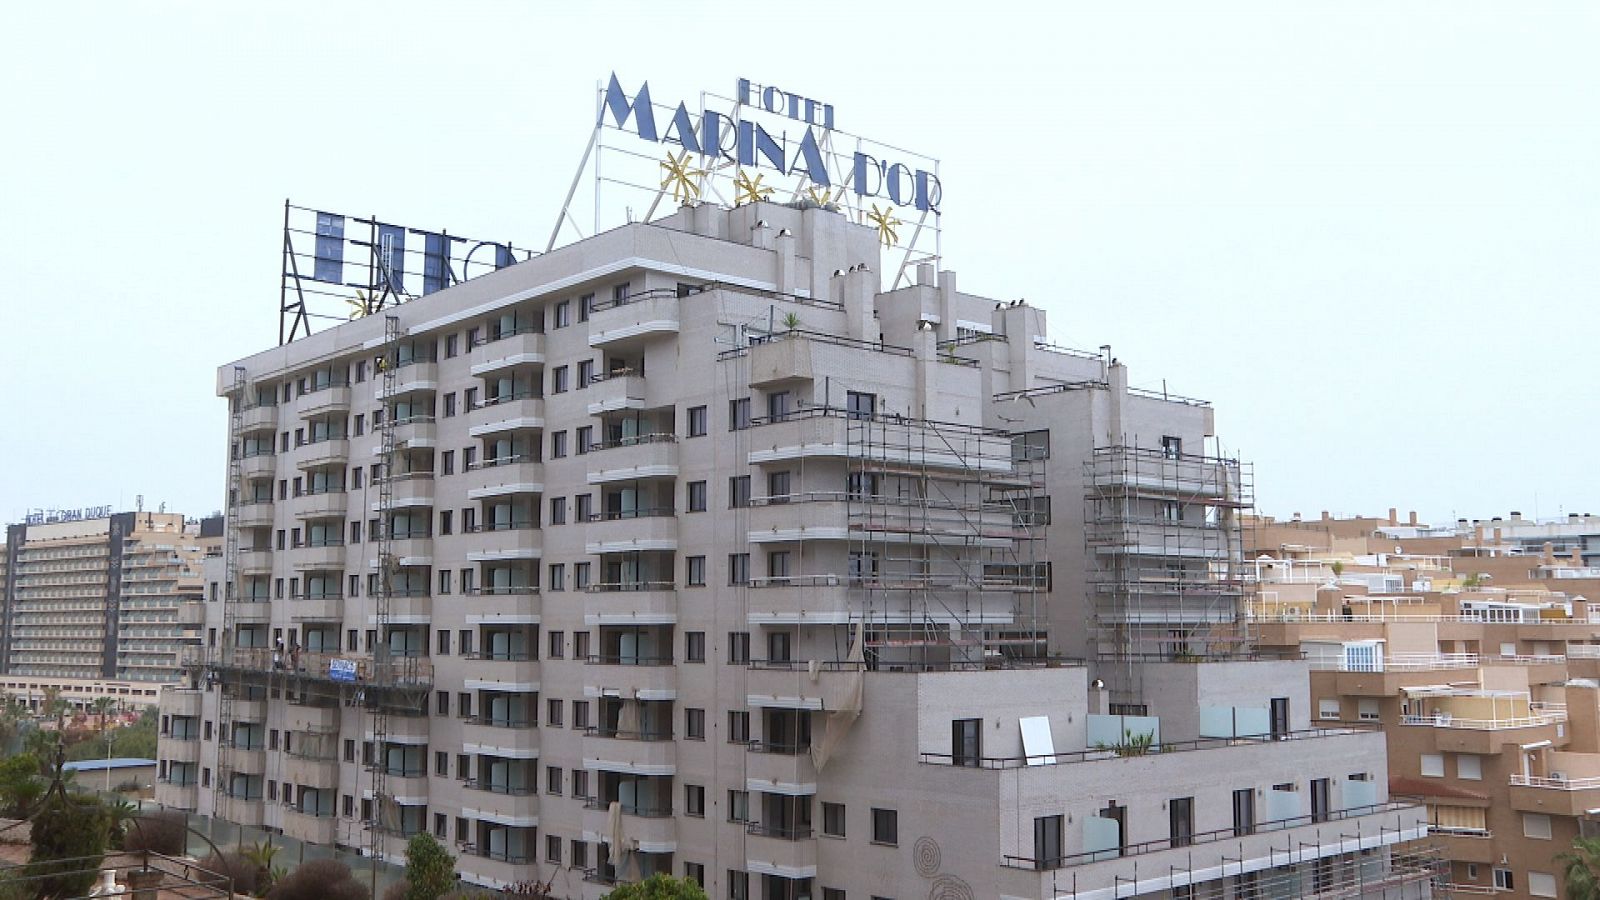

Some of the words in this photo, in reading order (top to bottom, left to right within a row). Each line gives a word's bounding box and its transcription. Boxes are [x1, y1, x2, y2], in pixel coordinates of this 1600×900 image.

[739, 78, 842, 132] HOTEL
[598, 70, 831, 187] MARINA
[854, 152, 942, 215] D'OR
[85, 505, 112, 519] DUQUE
